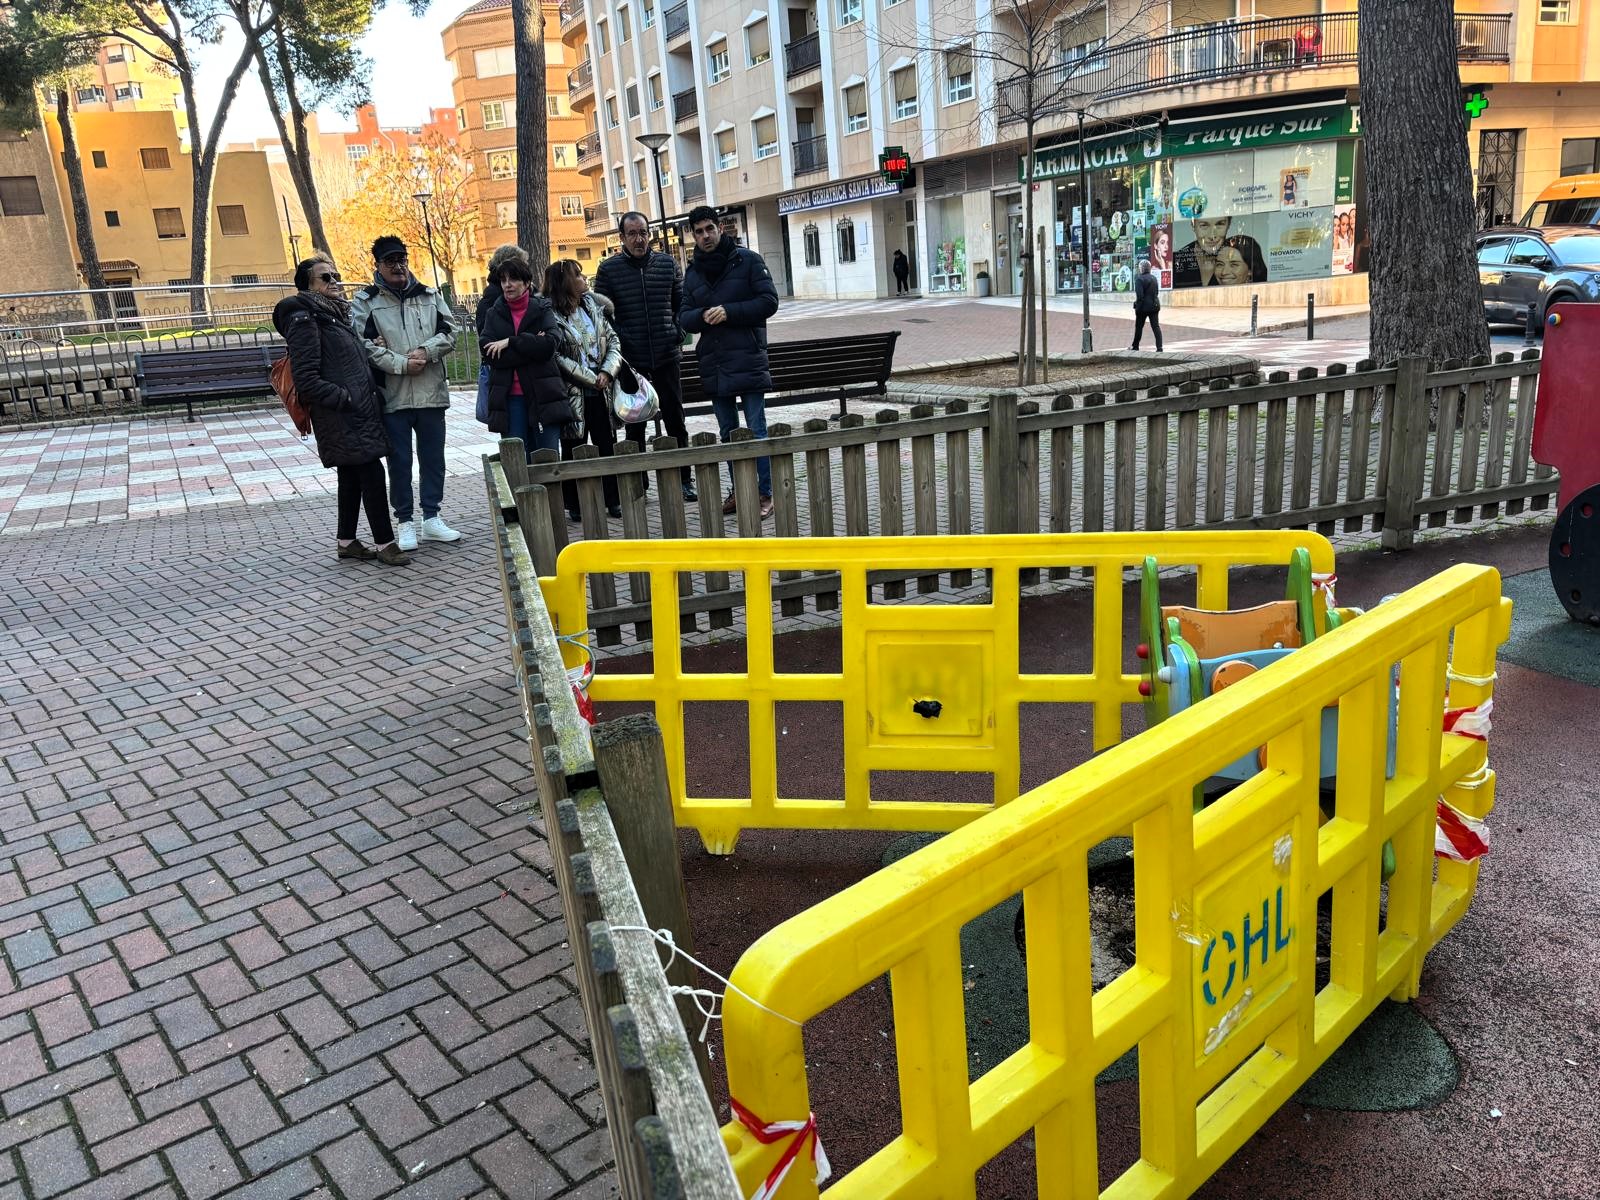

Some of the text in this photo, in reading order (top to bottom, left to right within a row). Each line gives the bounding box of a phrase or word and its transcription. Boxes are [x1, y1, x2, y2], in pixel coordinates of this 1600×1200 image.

[1280, 117, 1328, 135] Sur
[778, 192, 811, 212] RESIDENCIA
[812, 185, 848, 205] GERIATRICA
[848, 179, 870, 198] SANTA
[1288, 211, 1315, 219] VICHY
[1202, 886, 1292, 1006] OHL
